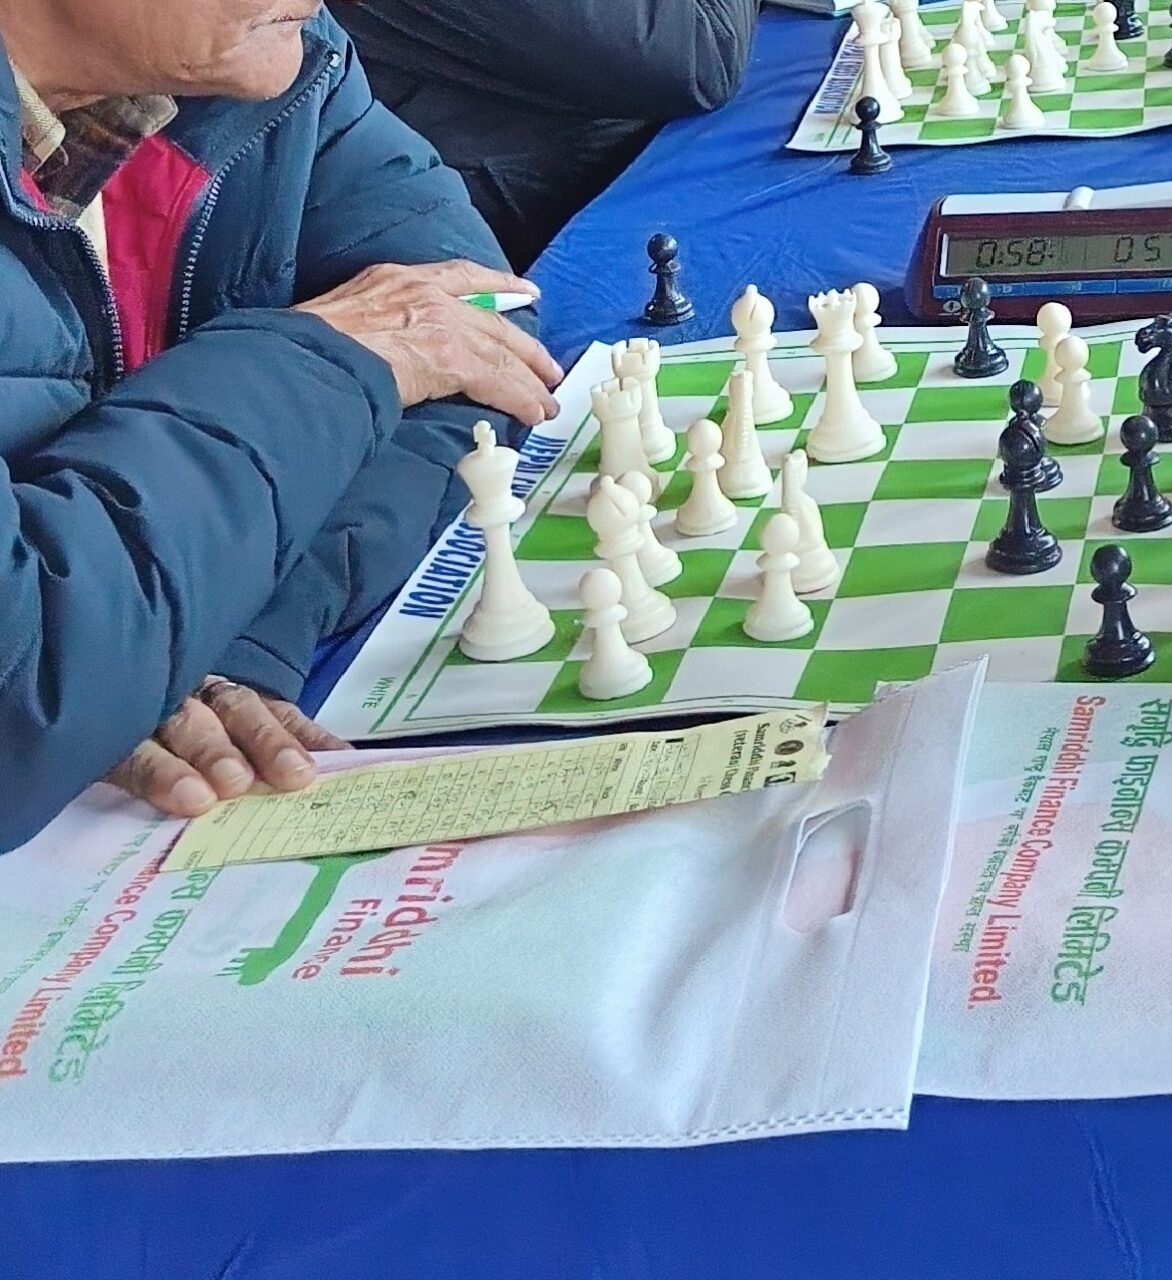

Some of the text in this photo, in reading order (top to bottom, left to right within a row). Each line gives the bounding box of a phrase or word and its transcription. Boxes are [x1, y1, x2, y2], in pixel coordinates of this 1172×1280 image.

[399, 522, 486, 618] SOCIATION
[362, 676, 398, 709] WHITE
[1051, 694, 1106, 775] Samriddhi
[741, 765, 760, 793] Financ
[1029, 776, 1079, 837] Finance
[1101, 754, 1159, 834] फाइनान्स
[115, 855, 161, 905] nance
[339, 845, 465, 978] mriddhi
[986, 839, 1054, 909] Company
[42, 909, 138, 983] Company
[292, 898, 382, 980] Finance
[1050, 905, 1119, 1007] लिमिटेड
